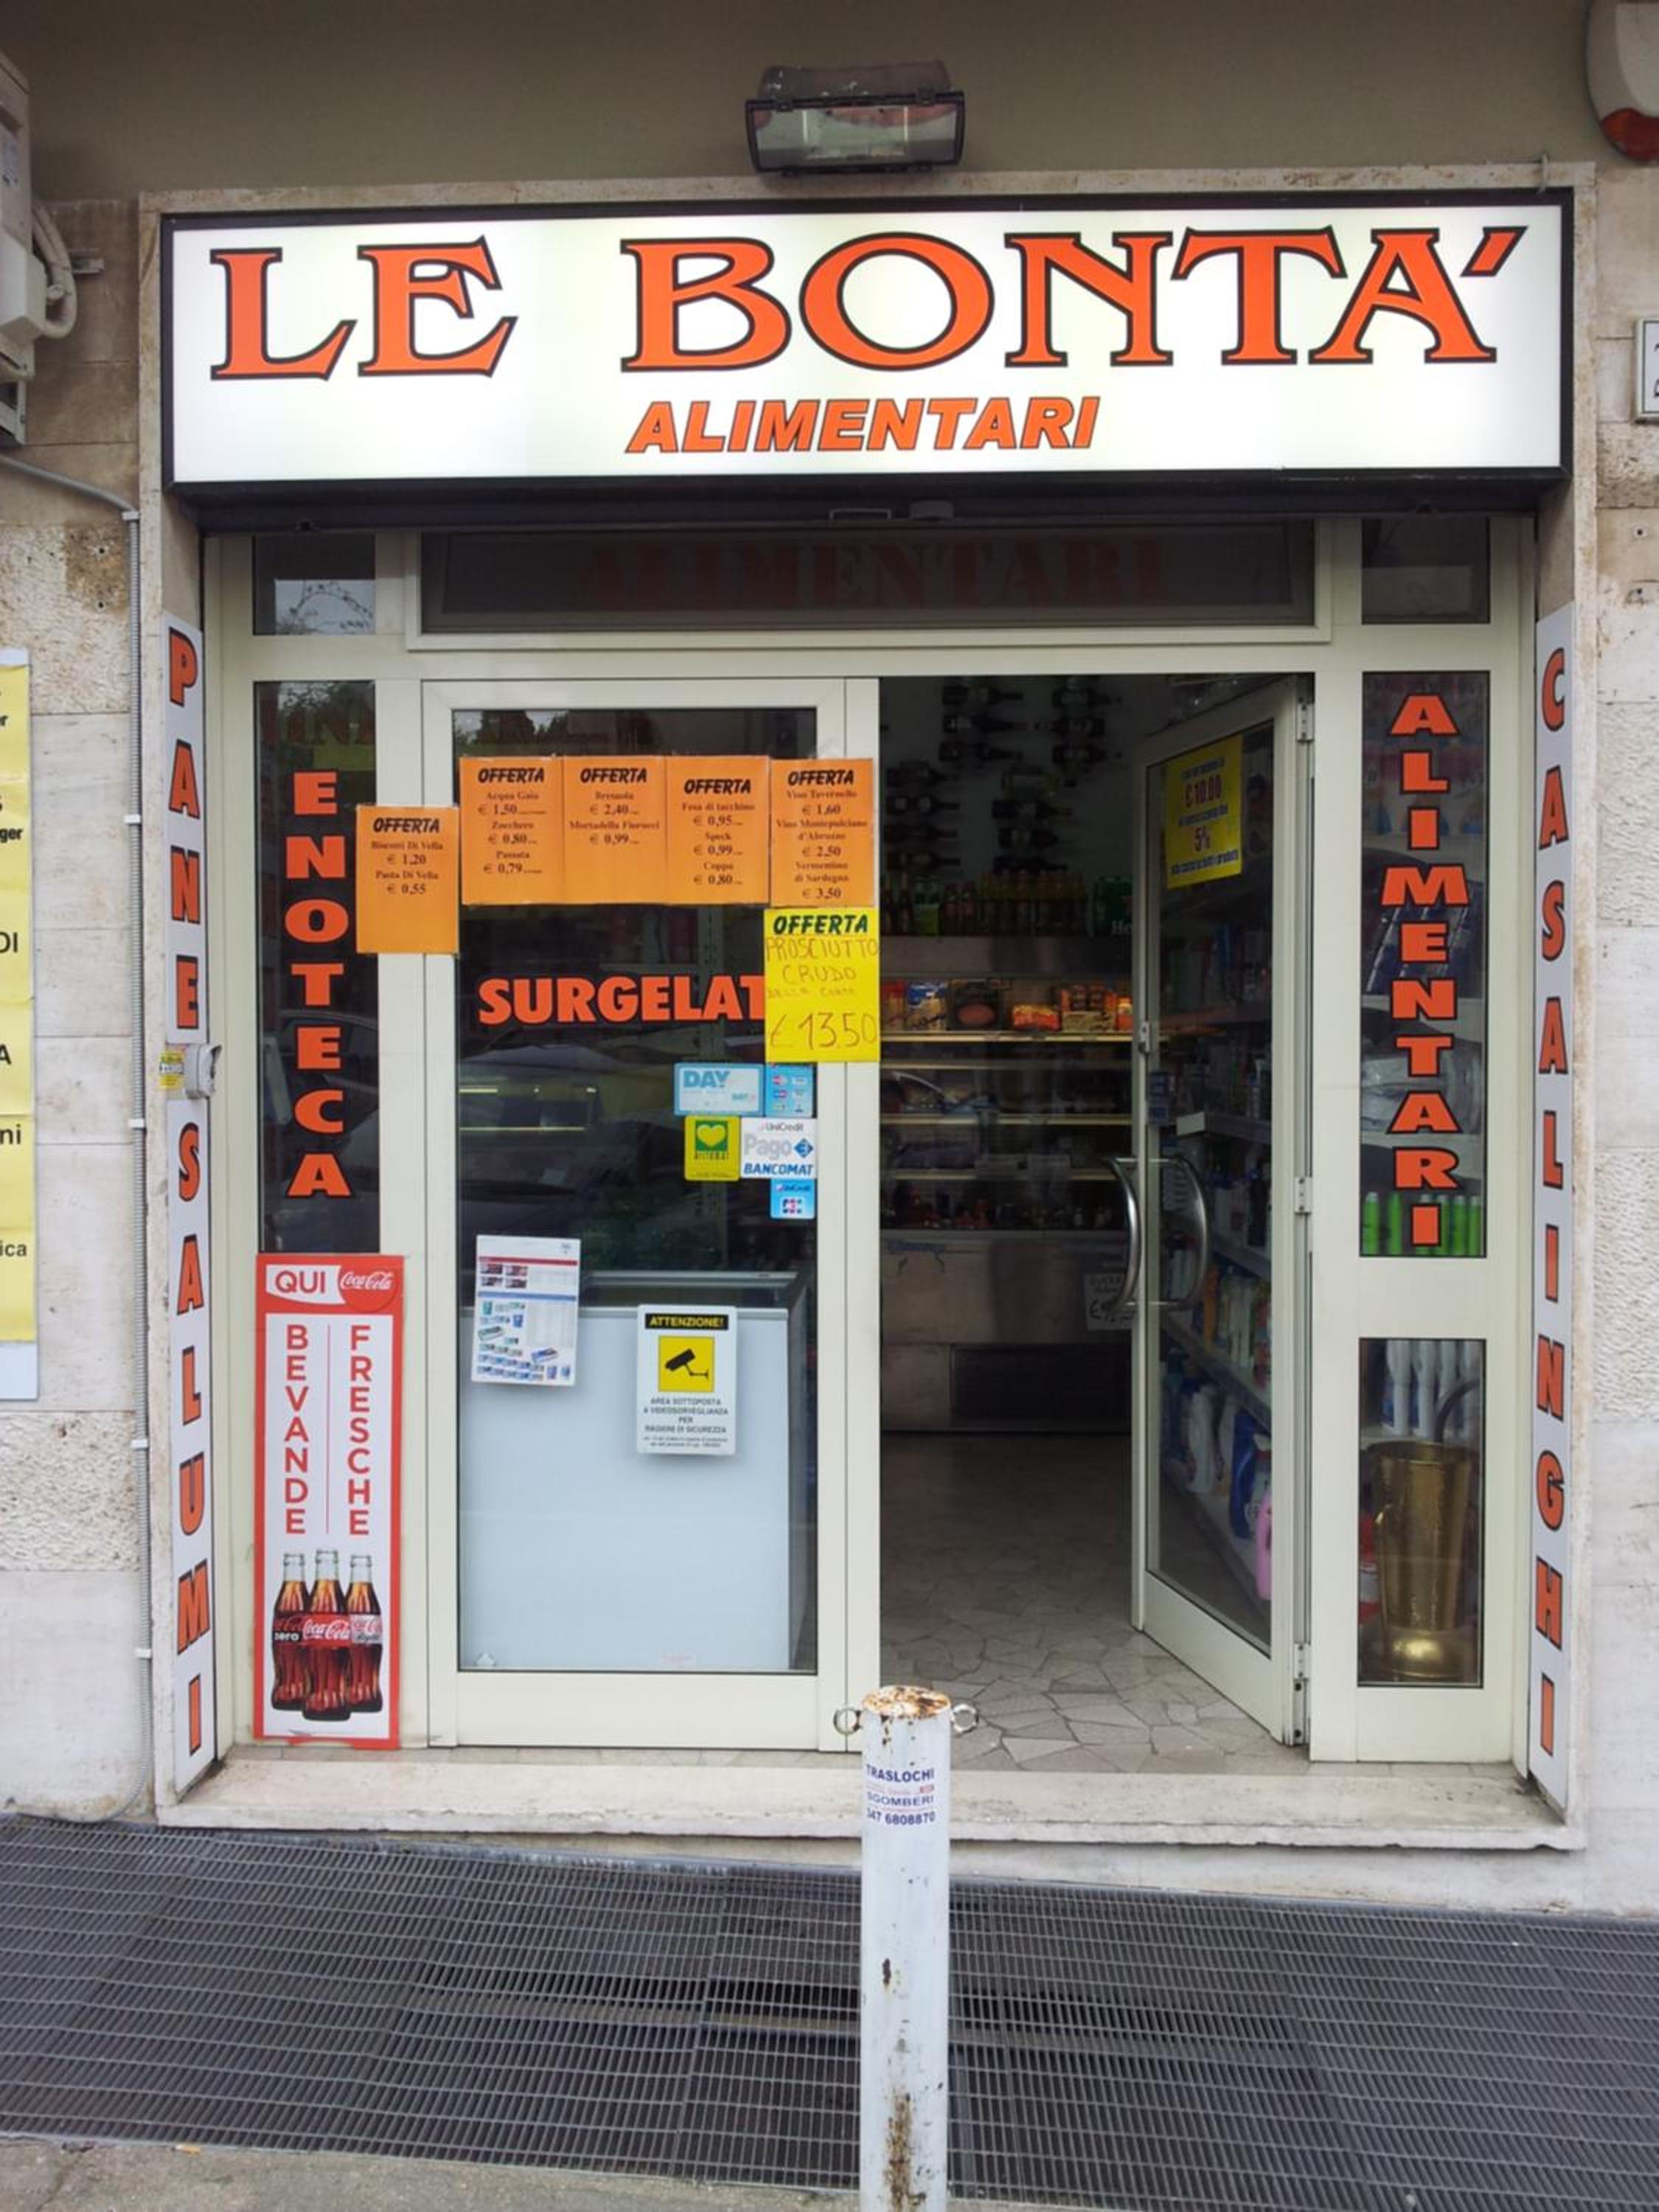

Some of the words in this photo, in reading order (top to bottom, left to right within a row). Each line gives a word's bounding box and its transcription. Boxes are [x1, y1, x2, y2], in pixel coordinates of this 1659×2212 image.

[210, 235, 518, 382] LE
[625, 396, 1100, 454] ALIMENTARI
[580, 537, 1169, 611] ALIMENTARI
[477, 767, 545, 783] OFFERTA
[580, 767, 647, 783] OFFERTA
[787, 769, 855, 786] OFFERTA
[684, 778, 751, 795] OFFERTA
[168, 626, 201, 1031] PANE
[373, 817, 440, 833] OFFERTA
[496, 850, 530, 859] Passata
[703, 861, 734, 872] Coppa
[773, 914, 868, 936] OFFERTA
[767, 936, 878, 962] PROSCIUTTO
[782, 964, 858, 985] CRUDO
[1380, 693, 1471, 1248] ALIMENTARI
[285, 771, 354, 1197] ENOTECA
[478, 975, 765, 1026] SURGELAT
[684, 1070, 731, 1088] DAY
[765, 1123, 803, 1132] UniCredit
[743, 1134, 792, 1161] Pago
[743, 1163, 814, 1175] BANCOMAT
[1535, 647, 1570, 1757] CASALINGHI
[275, 1270, 326, 1294] QUI
[672, 1397, 722, 1405] SOTTOPOSTA
[284, 1324, 310, 1535] BEVANDE
[348, 1324, 374, 1536] FRESCHE
[644, 1425, 675, 1433] RAGIONI
[686, 1425, 727, 1433] SICUREZZA
[678, 1416, 693, 1424] PER
[177, 1121, 211, 1756] SALUMI
[866, 1764, 935, 1783] TRASLOCHI
[885, 1810, 936, 1826] 6808870
